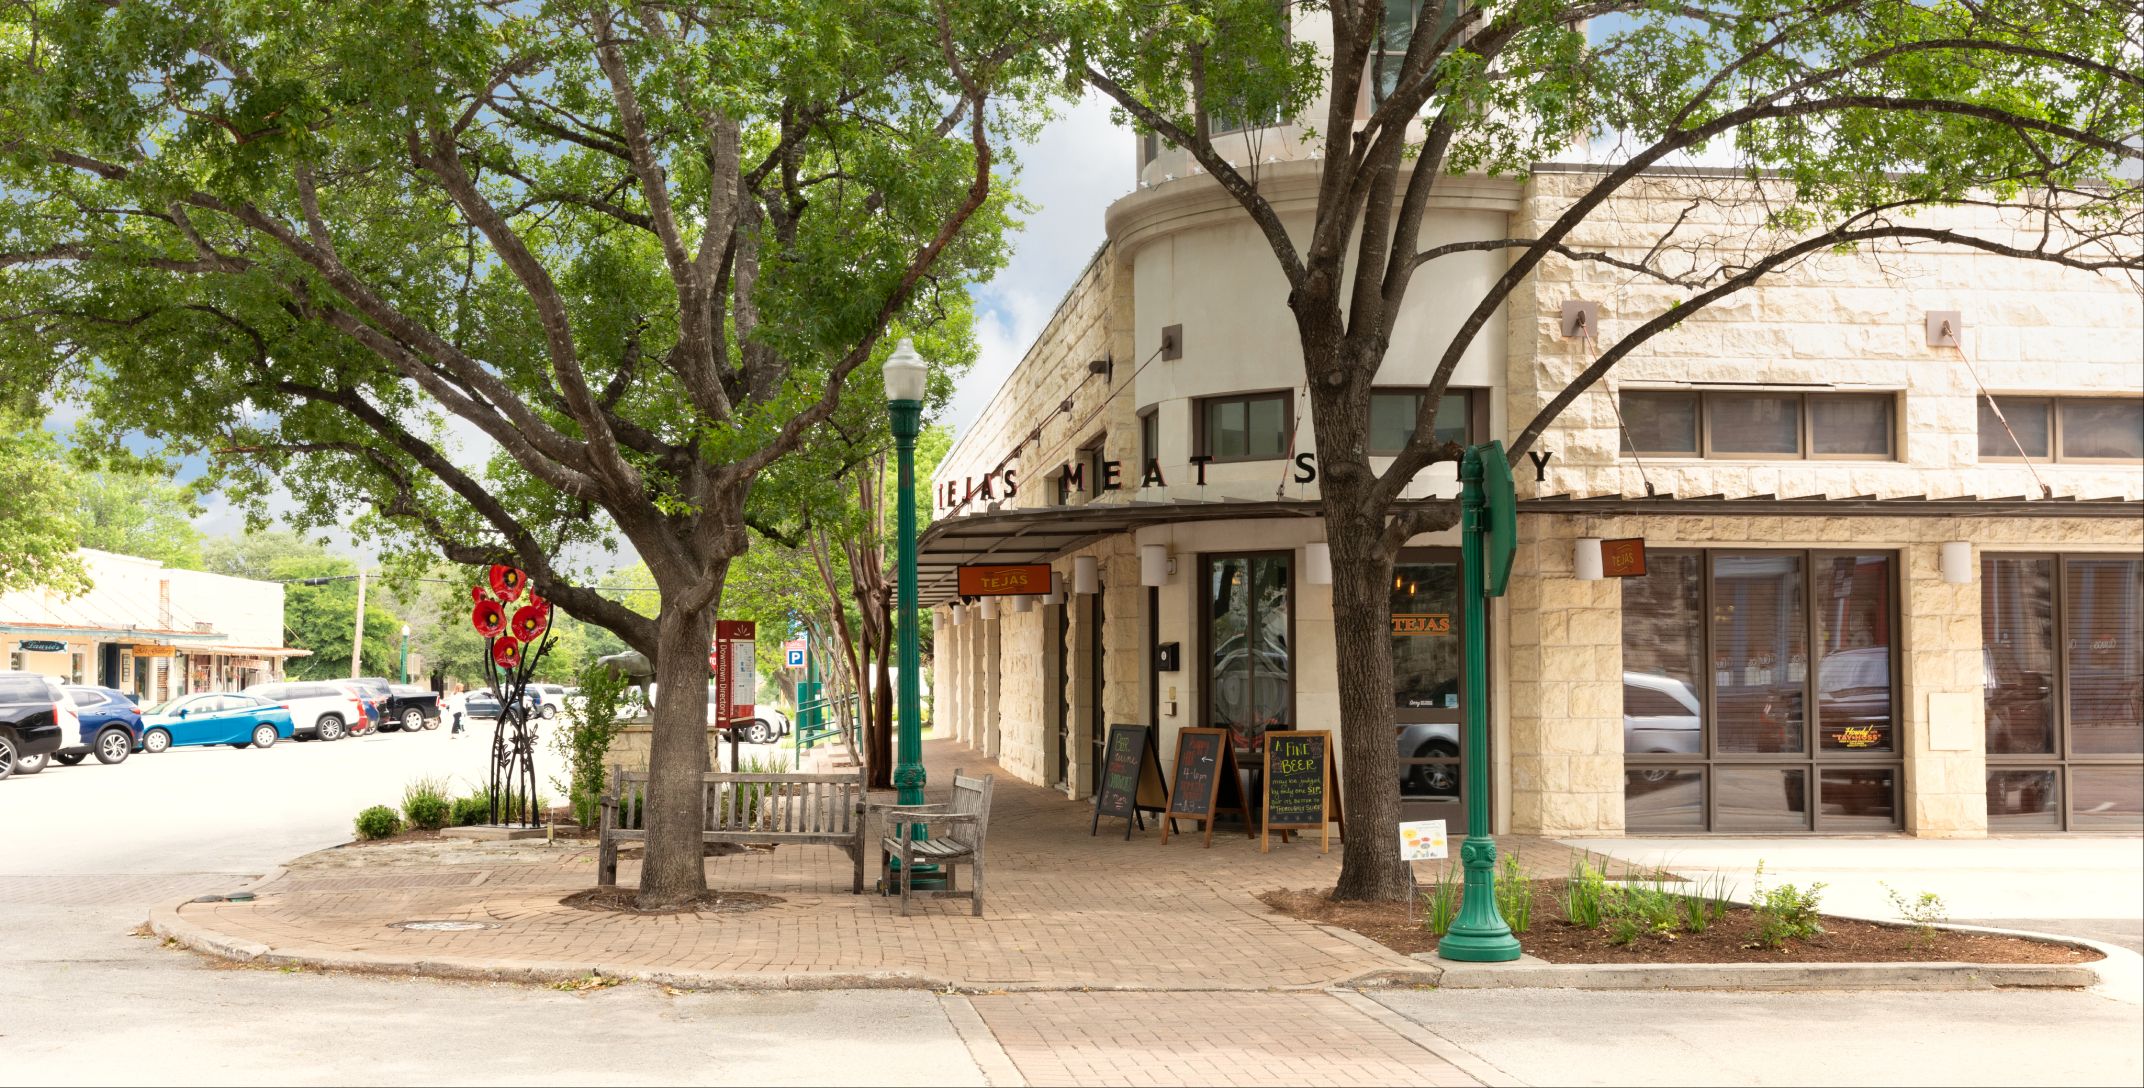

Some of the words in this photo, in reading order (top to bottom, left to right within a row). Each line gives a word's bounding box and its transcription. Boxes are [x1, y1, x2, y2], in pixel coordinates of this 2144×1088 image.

[939, 469, 1018, 510] TEJAS
[1062, 456, 1215, 492] MEAT
[980, 576, 1028, 589] TEJAS
[1392, 617, 1450, 632] TEJAS
[719, 644, 728, 682] Downtown
[791, 652, 801, 664] P
[718, 683, 728, 718] Directory
[1275, 740, 1282, 752] A
[1286, 741, 1310, 757] FINE
[1281, 759, 1317, 774] BEER
